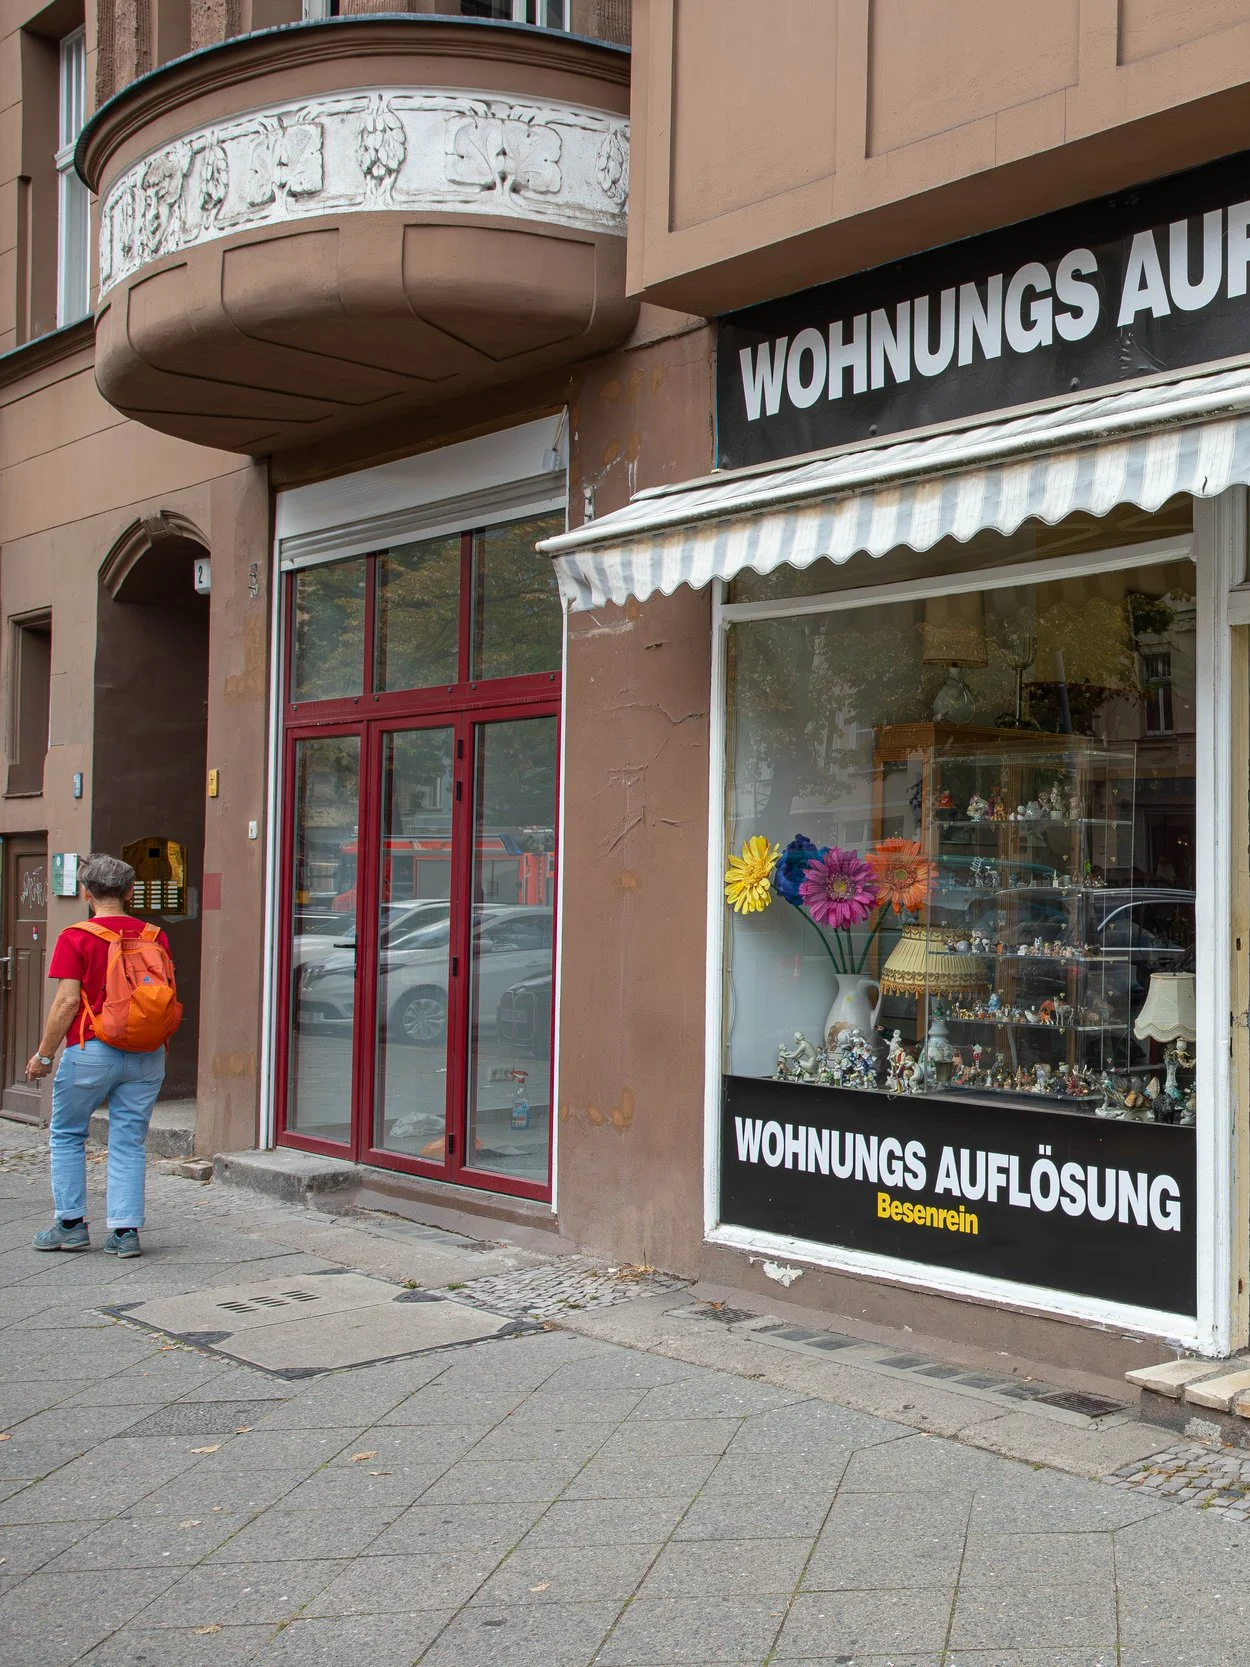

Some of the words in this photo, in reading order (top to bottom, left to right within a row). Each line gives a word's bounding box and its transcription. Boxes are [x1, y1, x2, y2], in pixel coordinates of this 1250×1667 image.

[739, 248, 1100, 422] WOHNUNGS
[735, 1116, 927, 1191] WOHNUNGS
[935, 1144, 1181, 1232] AUFLÖSUNG
[877, 1192, 979, 1235] Besenrein
